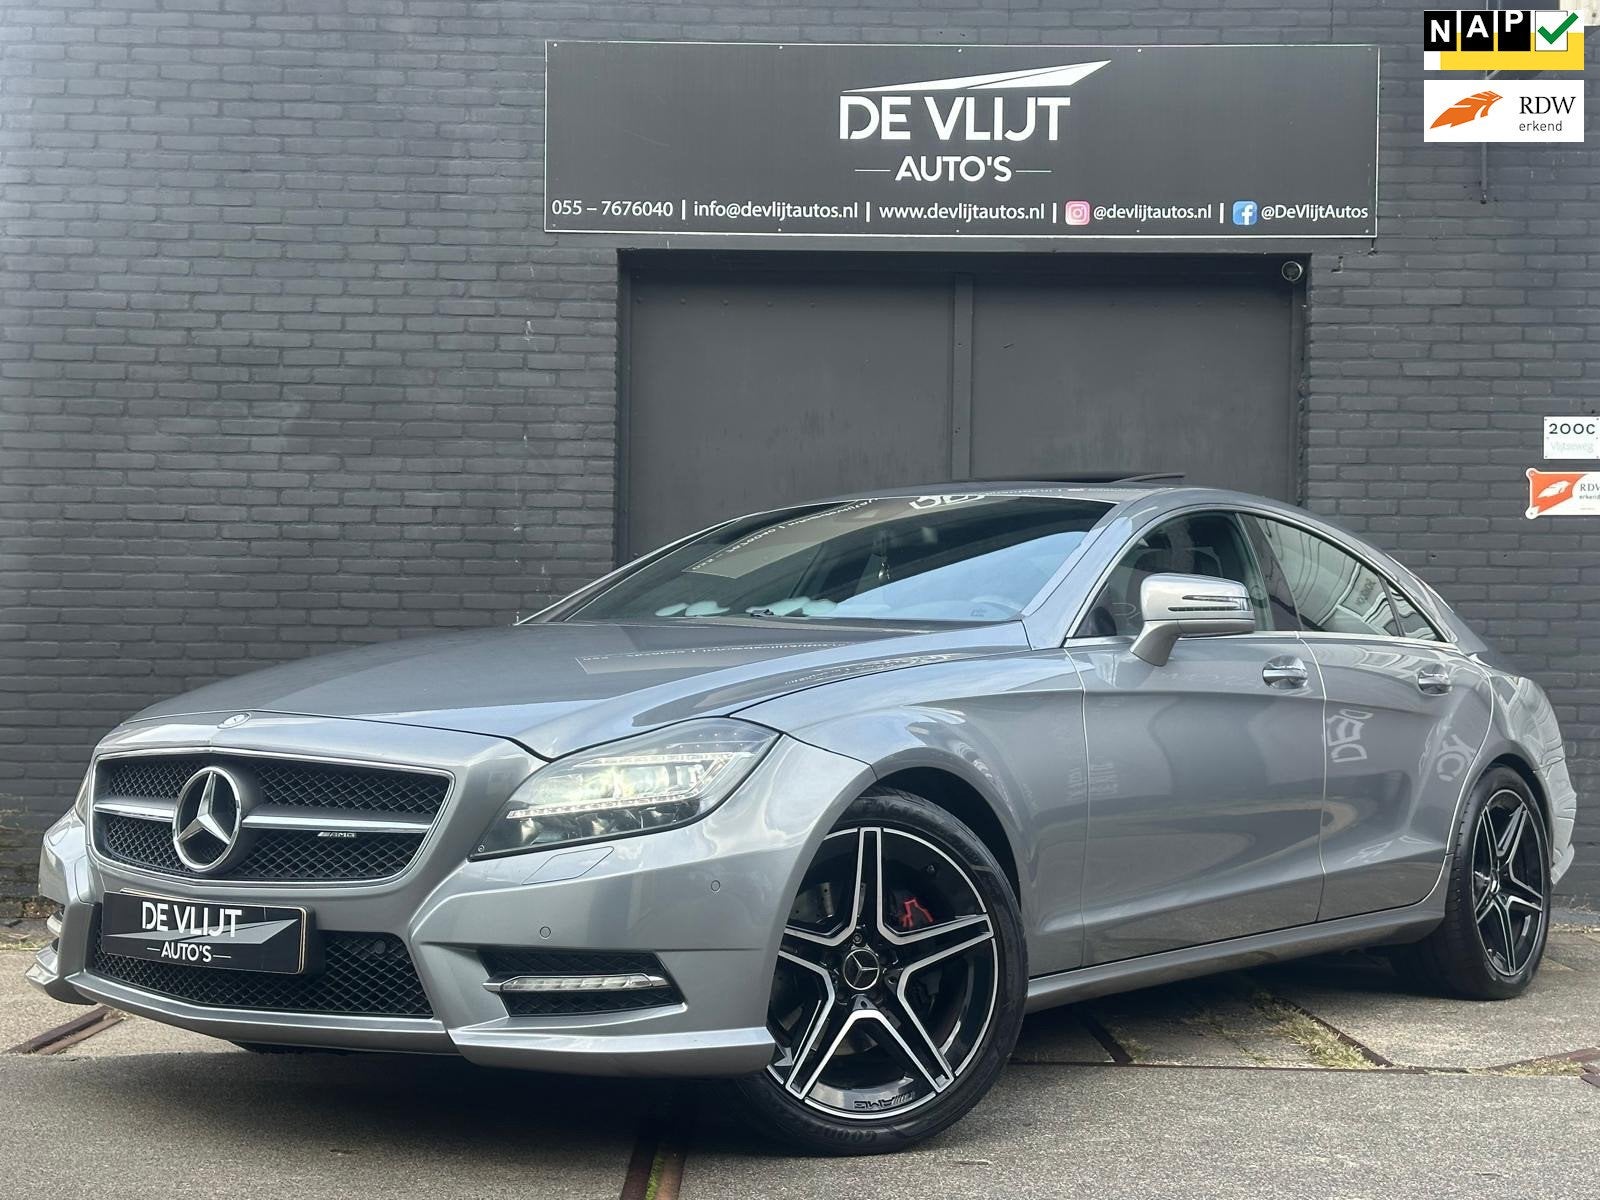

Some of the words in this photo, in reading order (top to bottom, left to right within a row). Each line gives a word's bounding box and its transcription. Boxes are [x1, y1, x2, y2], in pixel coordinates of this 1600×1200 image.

[839, 95, 911, 141] DE
[923, 96, 1071, 142] VLIJT
[894, 155, 1012, 182] AUTO'S
[551, 199, 583, 216] 055
[601, 200, 674, 217] 7676040
[693, 199, 858, 222] info@devlijtautos.nl
[878, 202, 1045, 223] www.devlijtautos.nl
[1093, 203, 1212, 223] @devlijtautos.nl
[1261, 203, 1369, 223] @DeVlijtAutos
[141, 901, 169, 932] DE
[173, 904, 243, 938] VLIJT
[160, 941, 212, 963] AUTO'S
